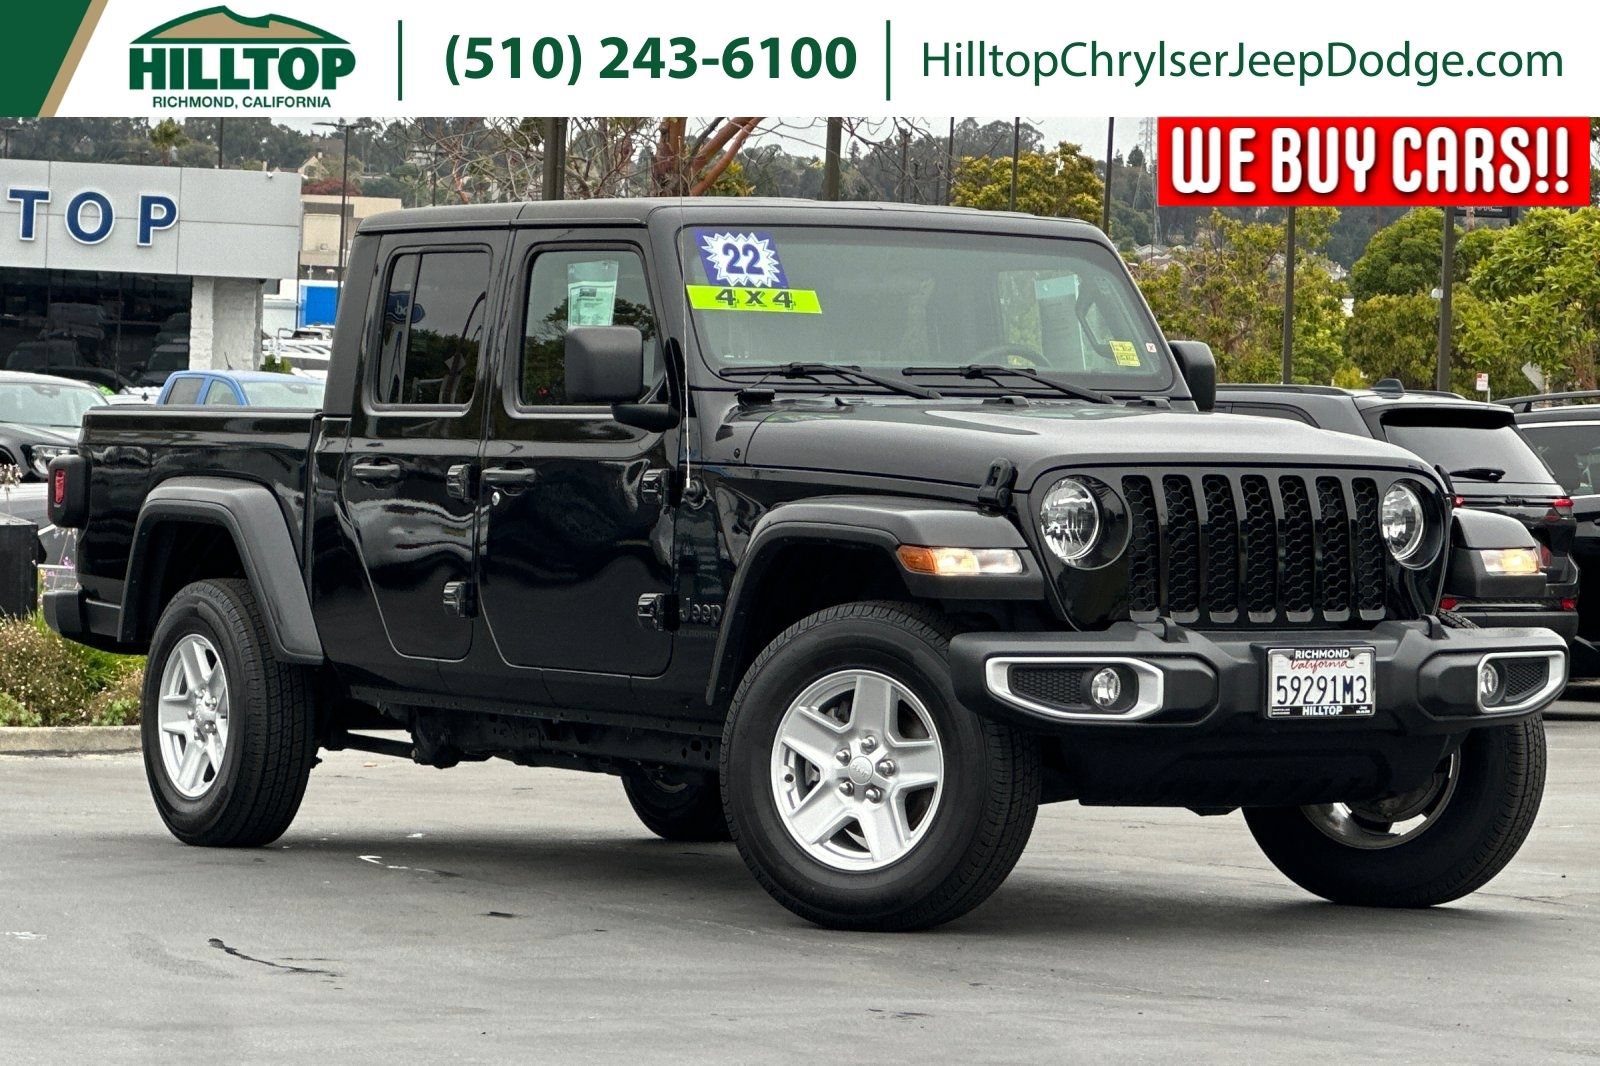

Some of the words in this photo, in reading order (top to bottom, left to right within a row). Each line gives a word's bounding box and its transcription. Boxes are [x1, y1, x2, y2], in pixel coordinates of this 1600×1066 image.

[721, 243, 764, 275] 22
[1295, 649, 1350, 658] RICHMOND
[1290, 659, 1355, 674] California
[1276, 675, 1367, 705] 59291M3
[1302, 706, 1343, 716] HILLTOP
